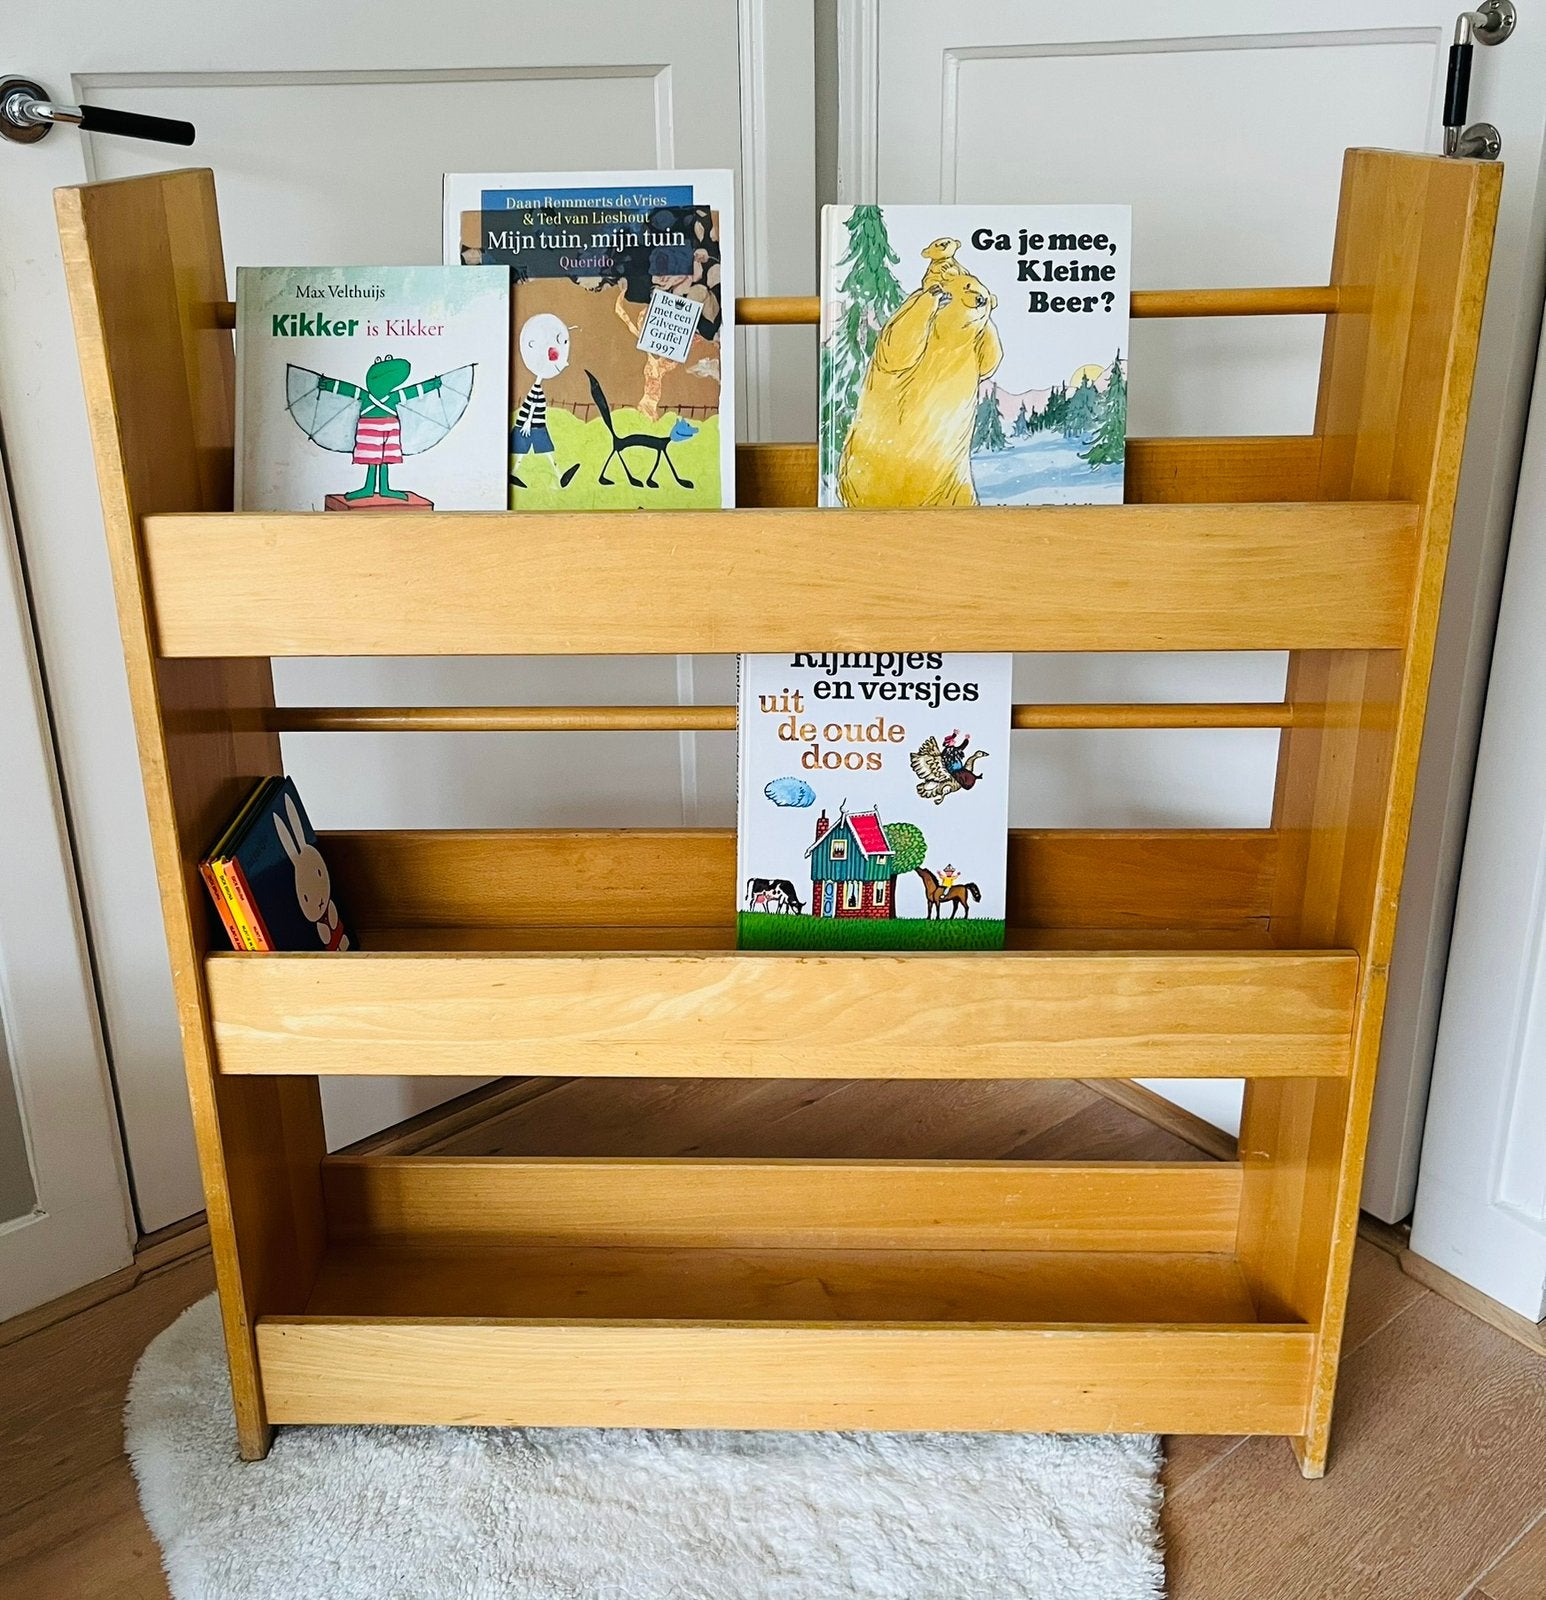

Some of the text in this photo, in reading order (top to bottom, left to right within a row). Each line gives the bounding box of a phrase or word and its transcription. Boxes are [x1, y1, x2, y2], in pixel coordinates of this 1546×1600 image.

[506, 194, 667, 210] Daan Remmerts de Vries
[522, 211, 650, 225] & Ted van Lieshout
[488, 228, 686, 255] Mijn tuin, mijn tuin
[971, 229, 1117, 256] Ga je mee,
[559, 255, 614, 270] Querido
[1016, 260, 1116, 282] Kleine
[296, 285, 386, 301] Max Velthuijs
[1028, 291, 1115, 313] Beer?
[272, 312, 444, 337] Kikker is Kikker
[649, 316, 689, 335] Zilveren
[654, 307, 691, 324] met een
[650, 328, 683, 345] Griffel
[650, 341, 675, 355] 1997
[759, 688, 805, 713] uit
[813, 675, 979, 708] en versjes
[777, 716, 906, 742] de oude
[801, 744, 883, 771] doos
